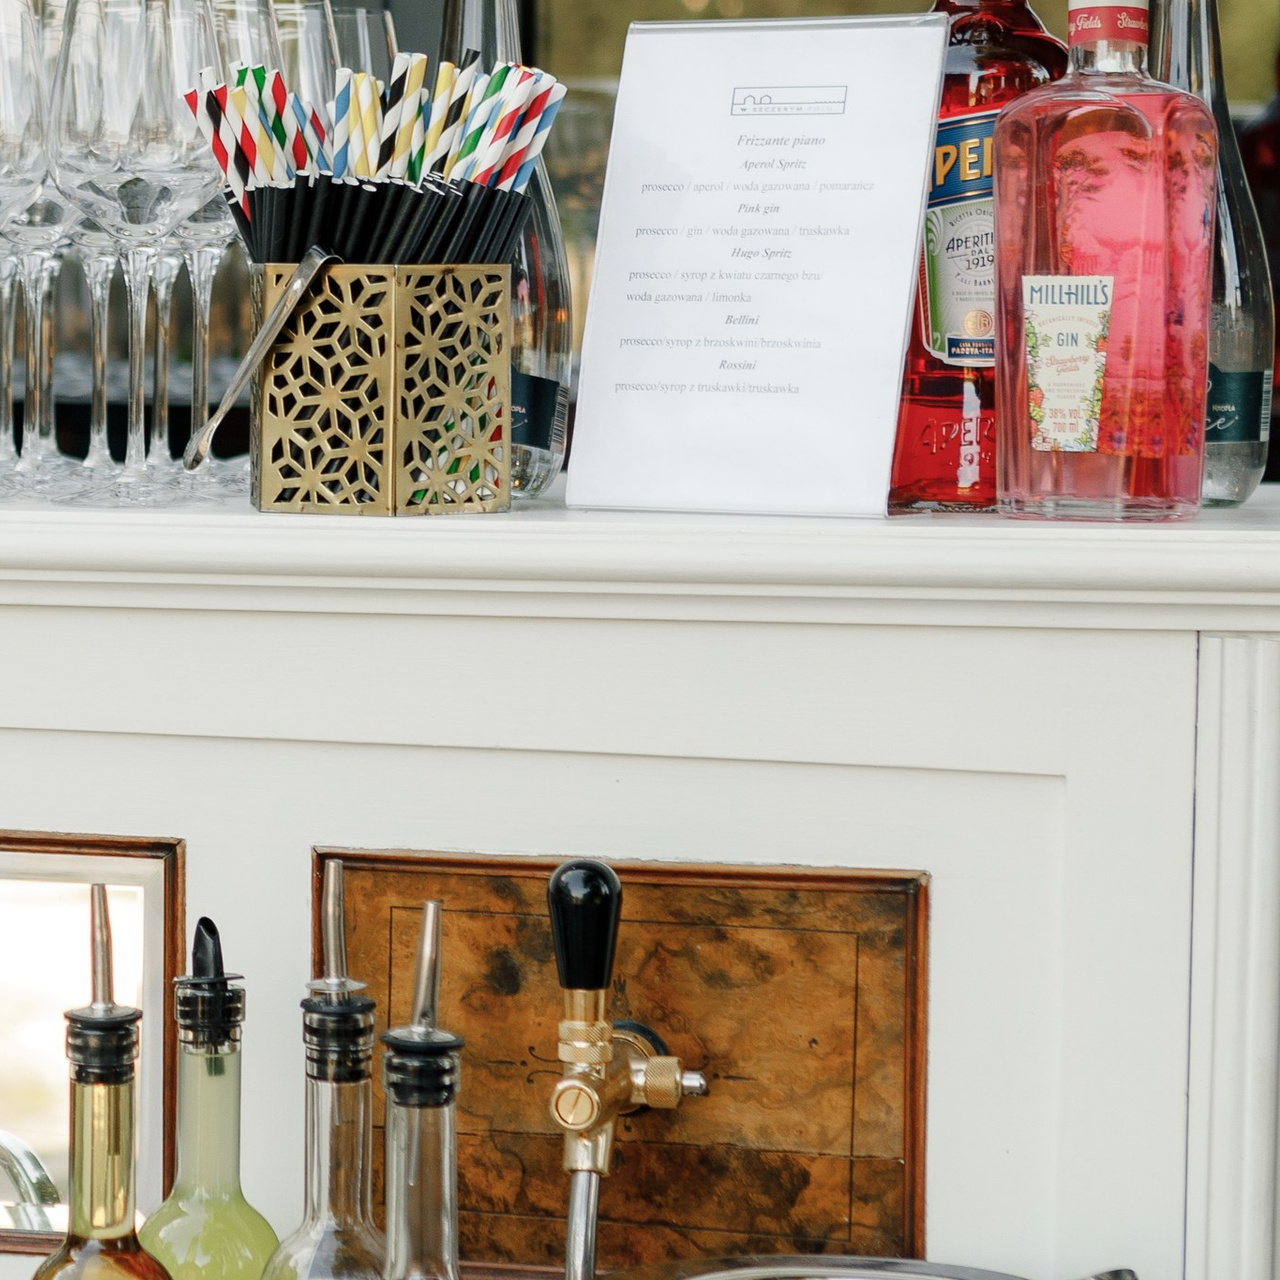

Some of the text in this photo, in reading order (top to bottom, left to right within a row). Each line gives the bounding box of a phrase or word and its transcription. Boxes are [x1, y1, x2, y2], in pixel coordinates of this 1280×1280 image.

[736, 134, 826, 148] Frizzante piano
[739, 159, 807, 170] Aperol Spritz
[641, 183, 685, 194] prosecco
[693, 181, 724, 193] aperol
[733, 181, 760, 192] woda
[761, 183, 811, 194] gazowana
[737, 203, 781, 215] Pink gin
[635, 227, 679, 238] prosecco
[686, 226, 703, 238] gin
[712, 226, 739, 236] woda
[740, 227, 790, 238] gazowana
[799, 226, 850, 237] truskawka
[946, 231, 994, 253] APERITI
[731, 248, 793, 260] Hugo Spritz
[966, 255, 995, 271] 1919
[628, 270, 672, 282] prosecco
[680, 271, 708, 282] syrop
[710, 272, 716, 280] z
[718, 270, 752, 280] kwiatu
[1029, 279, 1109, 305] MILLHILL'S
[626, 292, 652, 302] woda
[654, 293, 703, 305] gazowana
[712, 292, 752, 303] limonka
[724, 314, 761, 325] Bellini
[695, 339, 702, 347] z
[1057, 332, 1079, 347] GIN
[718, 359, 758, 371] Rossini
[689, 383, 696, 391] z
